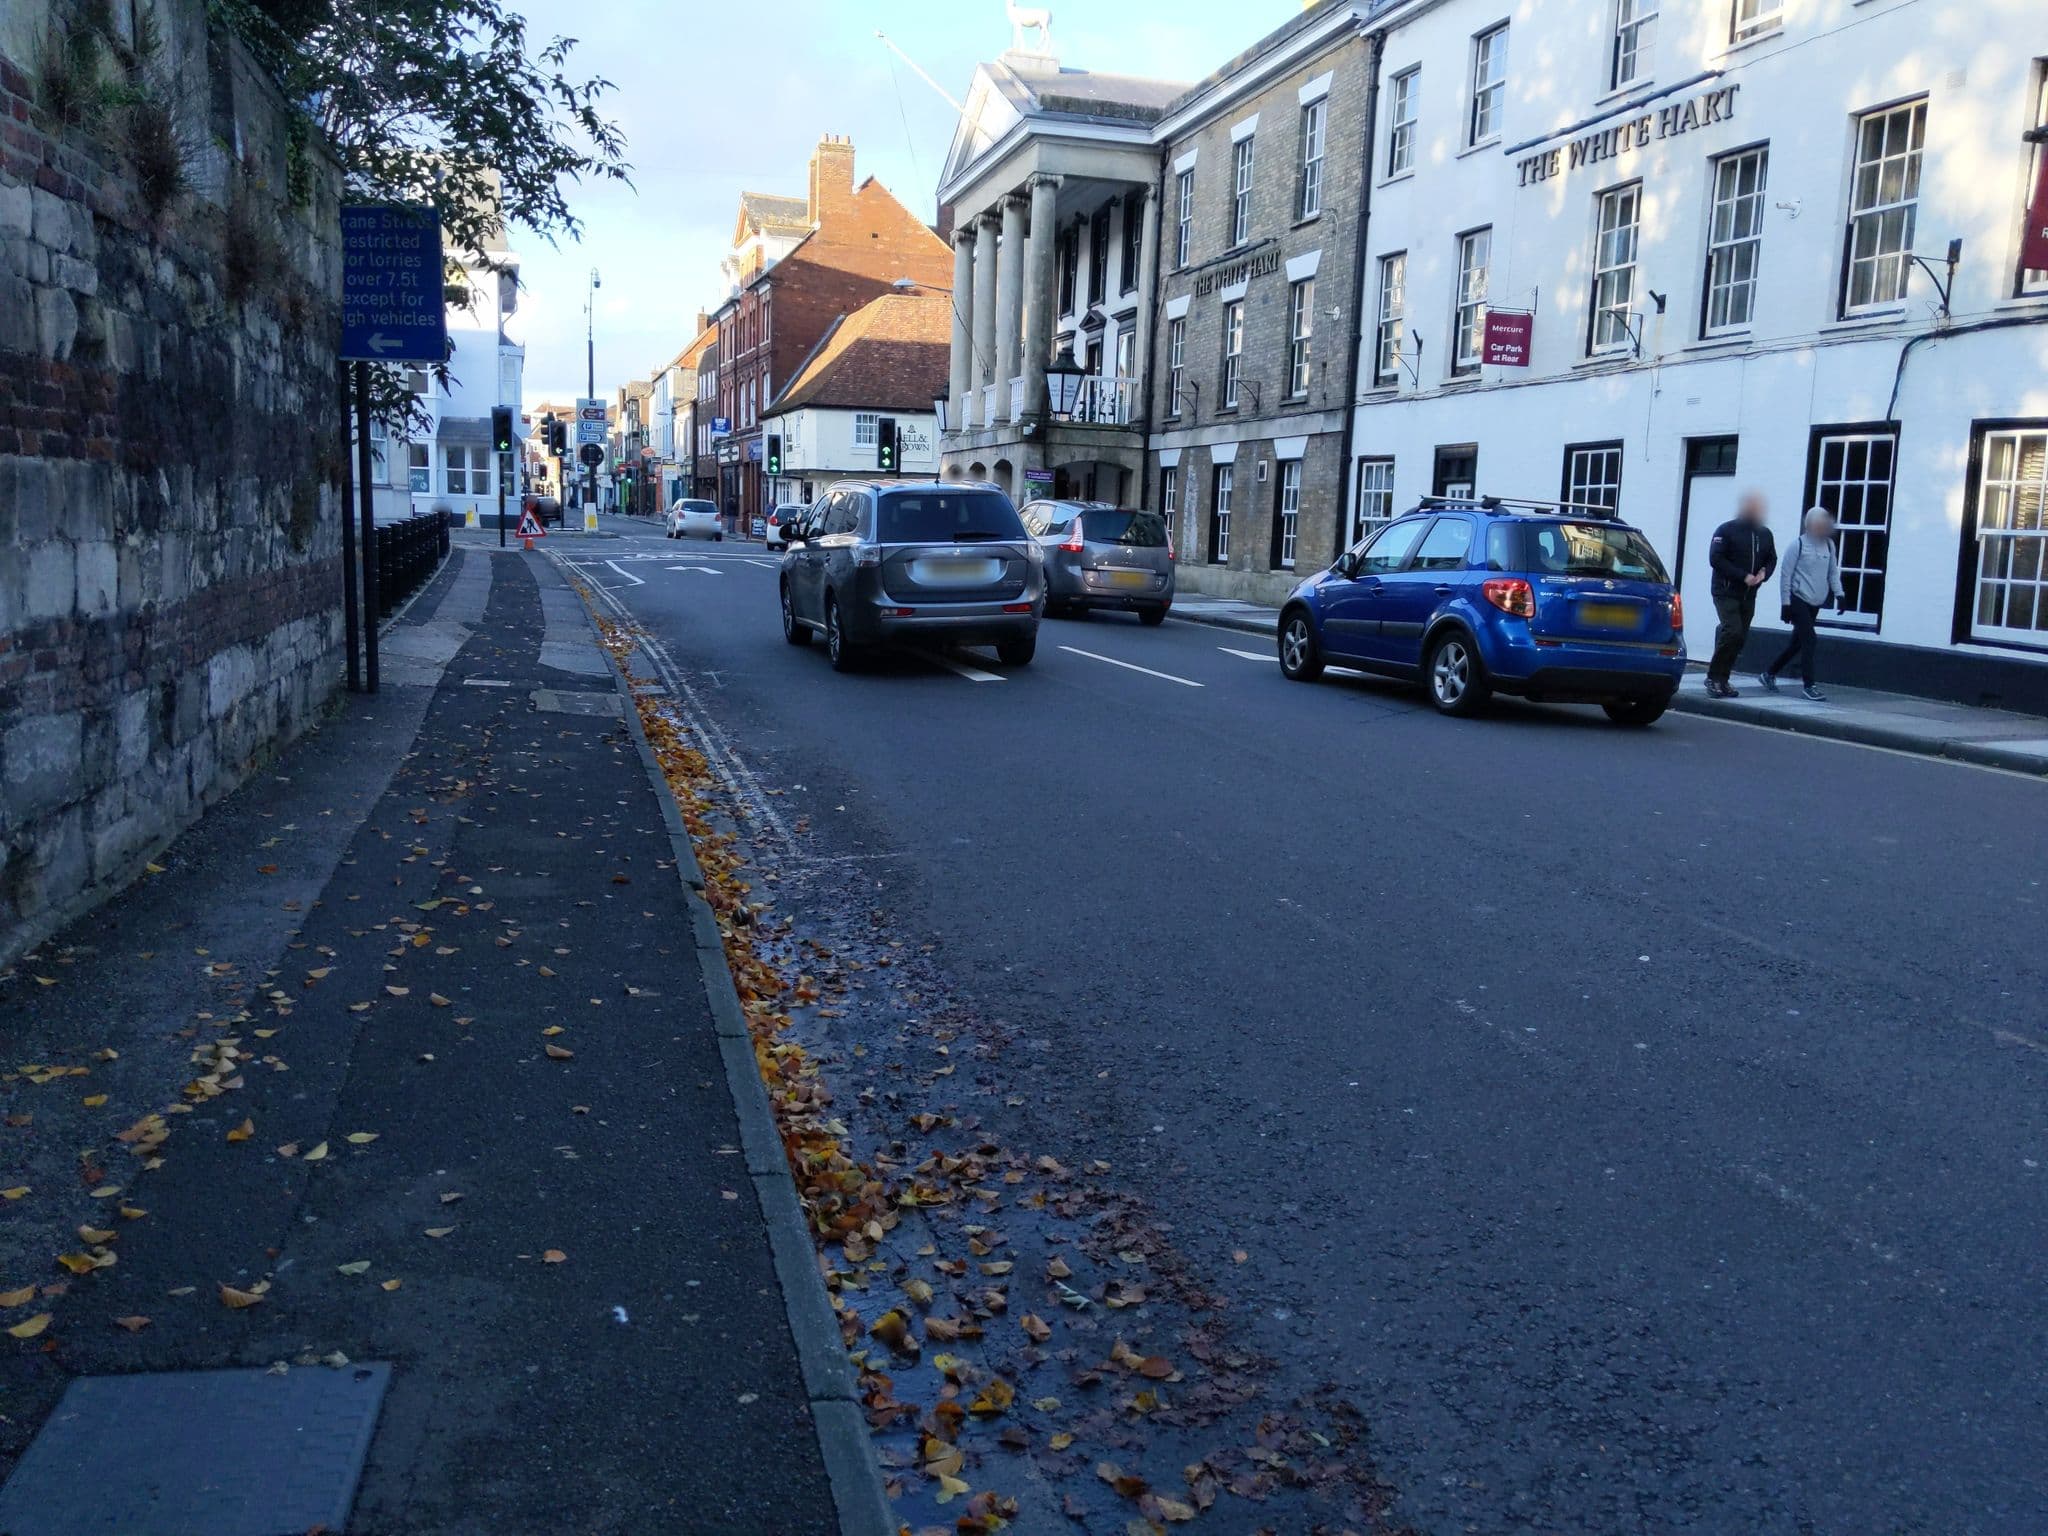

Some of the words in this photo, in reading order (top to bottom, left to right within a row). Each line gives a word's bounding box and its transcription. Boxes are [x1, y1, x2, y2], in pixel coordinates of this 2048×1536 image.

[1517, 149, 1561, 187] THE
[1568, 116, 1651, 170] WHITE
[1655, 83, 1740, 140] HART
[342, 216, 376, 229] rane
[370, 250, 422, 267] lorries
[346, 274, 382, 286] over
[387, 271, 419, 287] 7.5t
[1194, 273, 1213, 298] THE
[1215, 263, 1247, 290] WHITE
[1249, 249, 1281, 279] HART
[343, 291, 397, 308] except
[401, 291, 424, 306] for
[342, 308, 366, 327] igh
[371, 309, 436, 326] vehicles
[1492, 324, 1523, 334] Mercure
[1490, 343, 1504, 352] Car
[1505, 344, 1523, 353] Park
[1492, 354, 1500, 362] at
[1501, 354, 1519, 363] Rear
[902, 434, 919, 443] ELL
